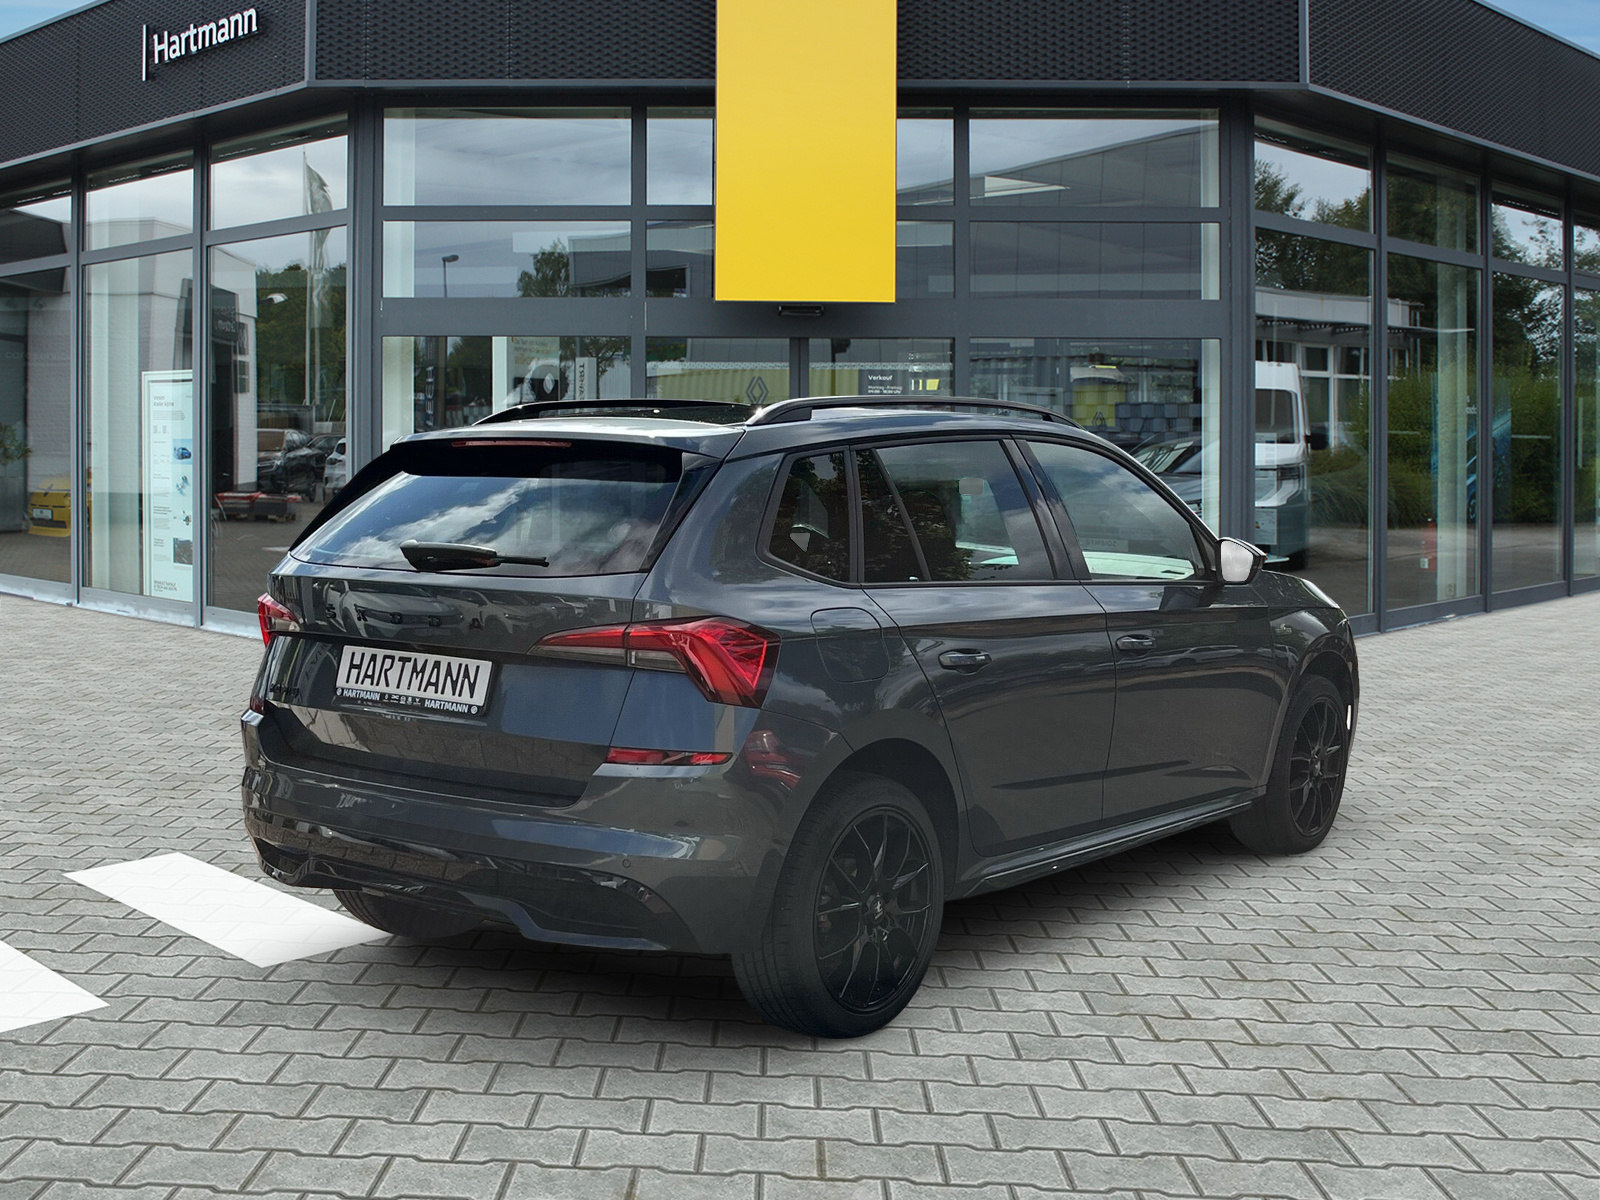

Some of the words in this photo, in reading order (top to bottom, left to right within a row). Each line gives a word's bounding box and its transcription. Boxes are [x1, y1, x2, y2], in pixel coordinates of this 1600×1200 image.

[152, 8, 258, 65] Hartmann
[345, 651, 480, 699] HARTMANN
[342, 688, 381, 701] HARTMANN
[424, 698, 469, 713] HARTMANN
